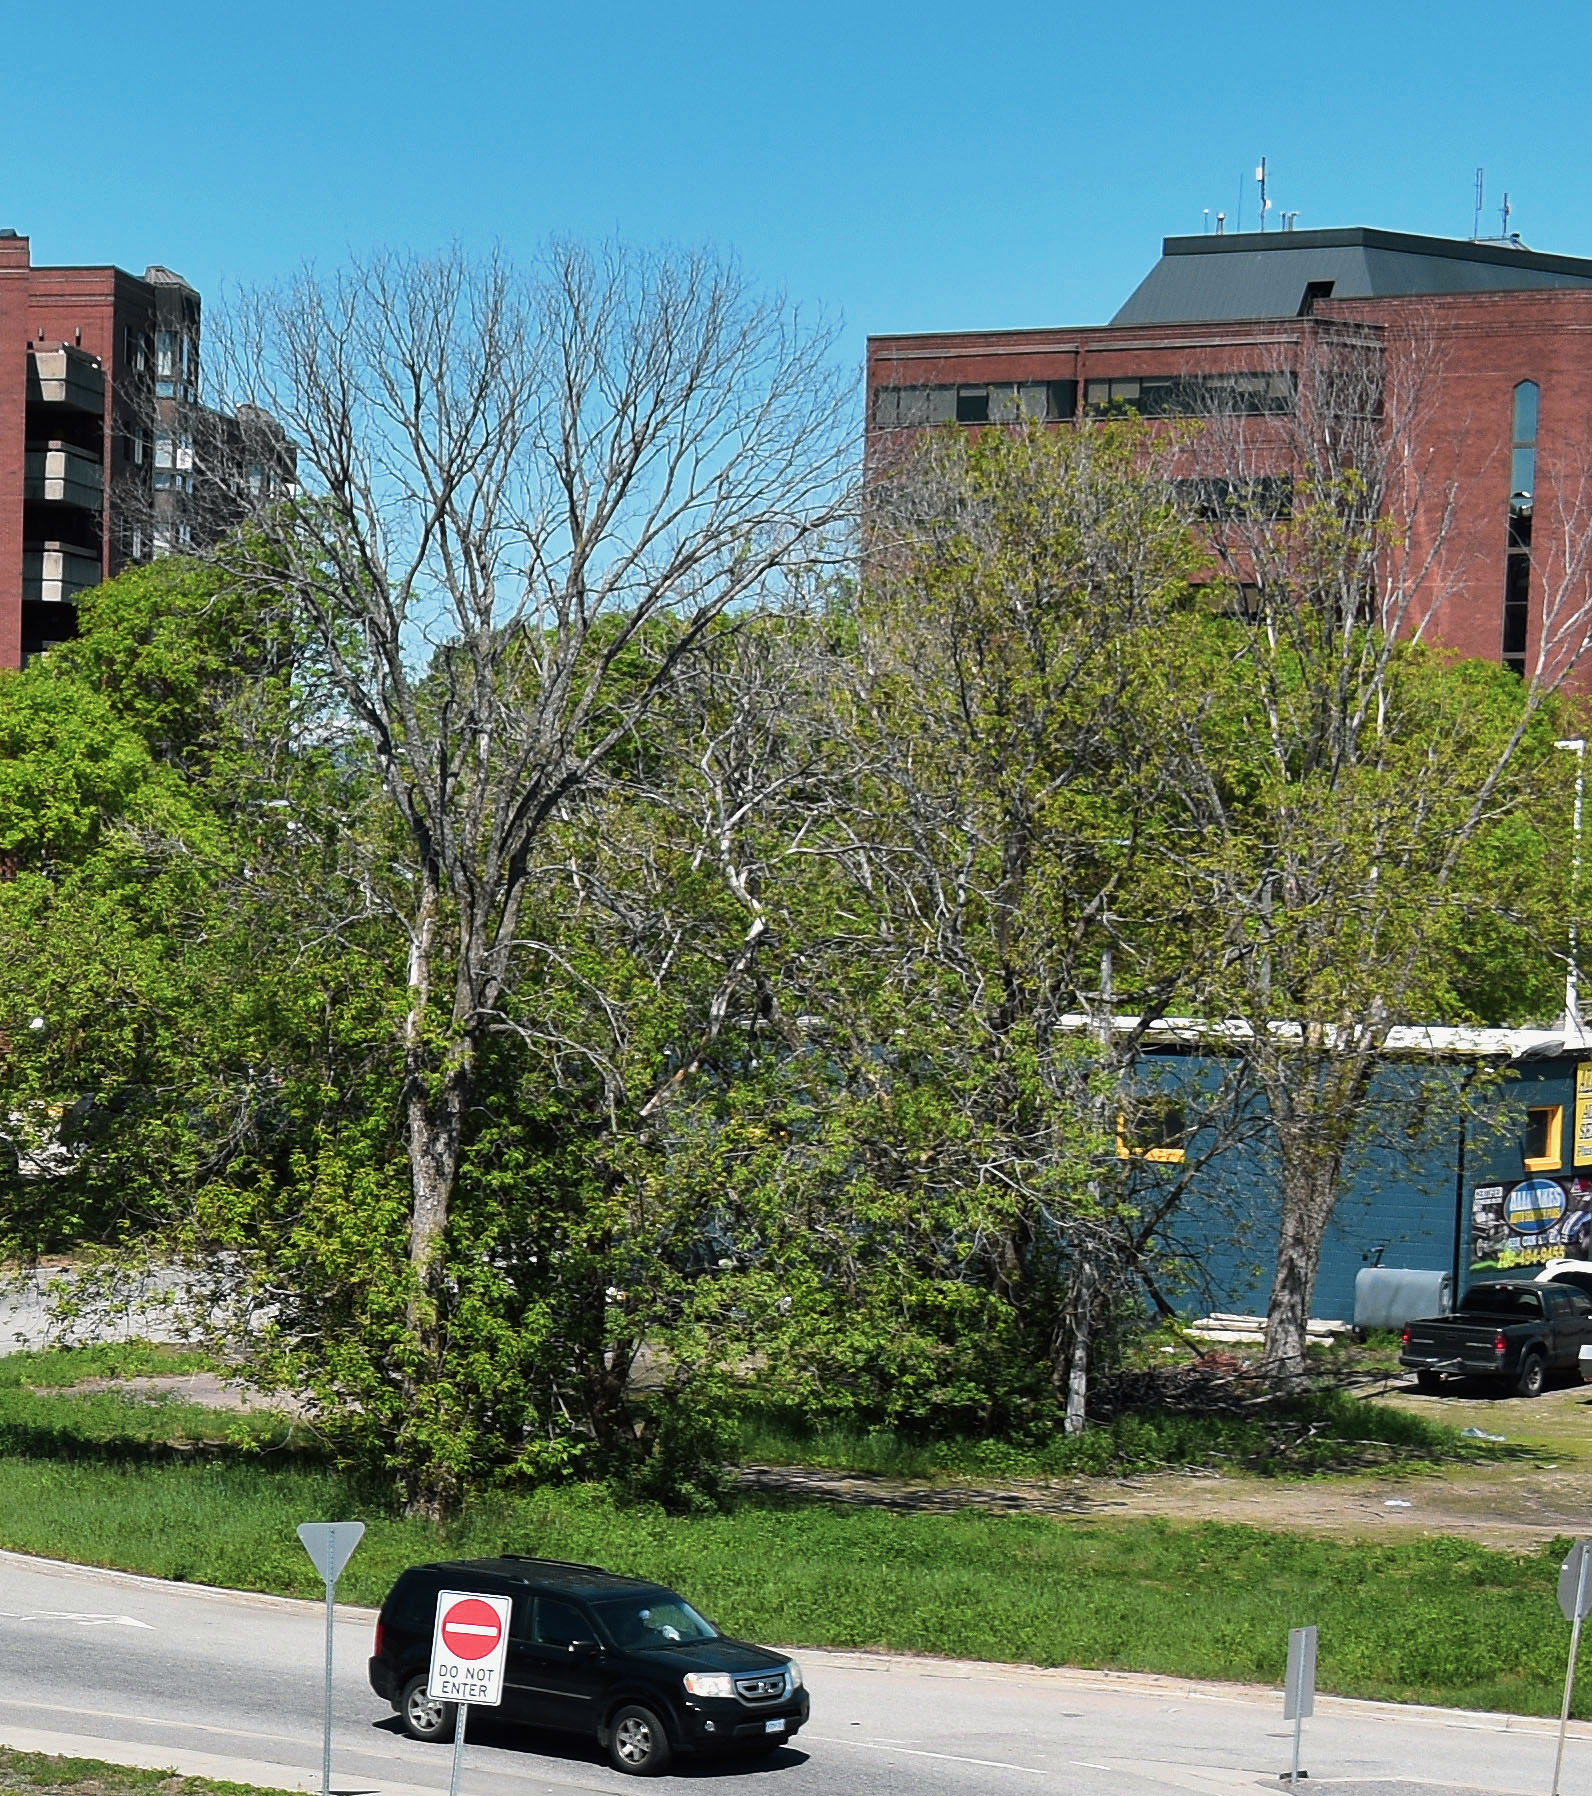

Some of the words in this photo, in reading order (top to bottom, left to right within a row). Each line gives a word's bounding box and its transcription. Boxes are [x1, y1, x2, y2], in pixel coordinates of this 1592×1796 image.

[439, 1664, 458, 1678] DO
[465, 1667, 494, 1682] NOT
[441, 1680, 487, 1697] ENTER
